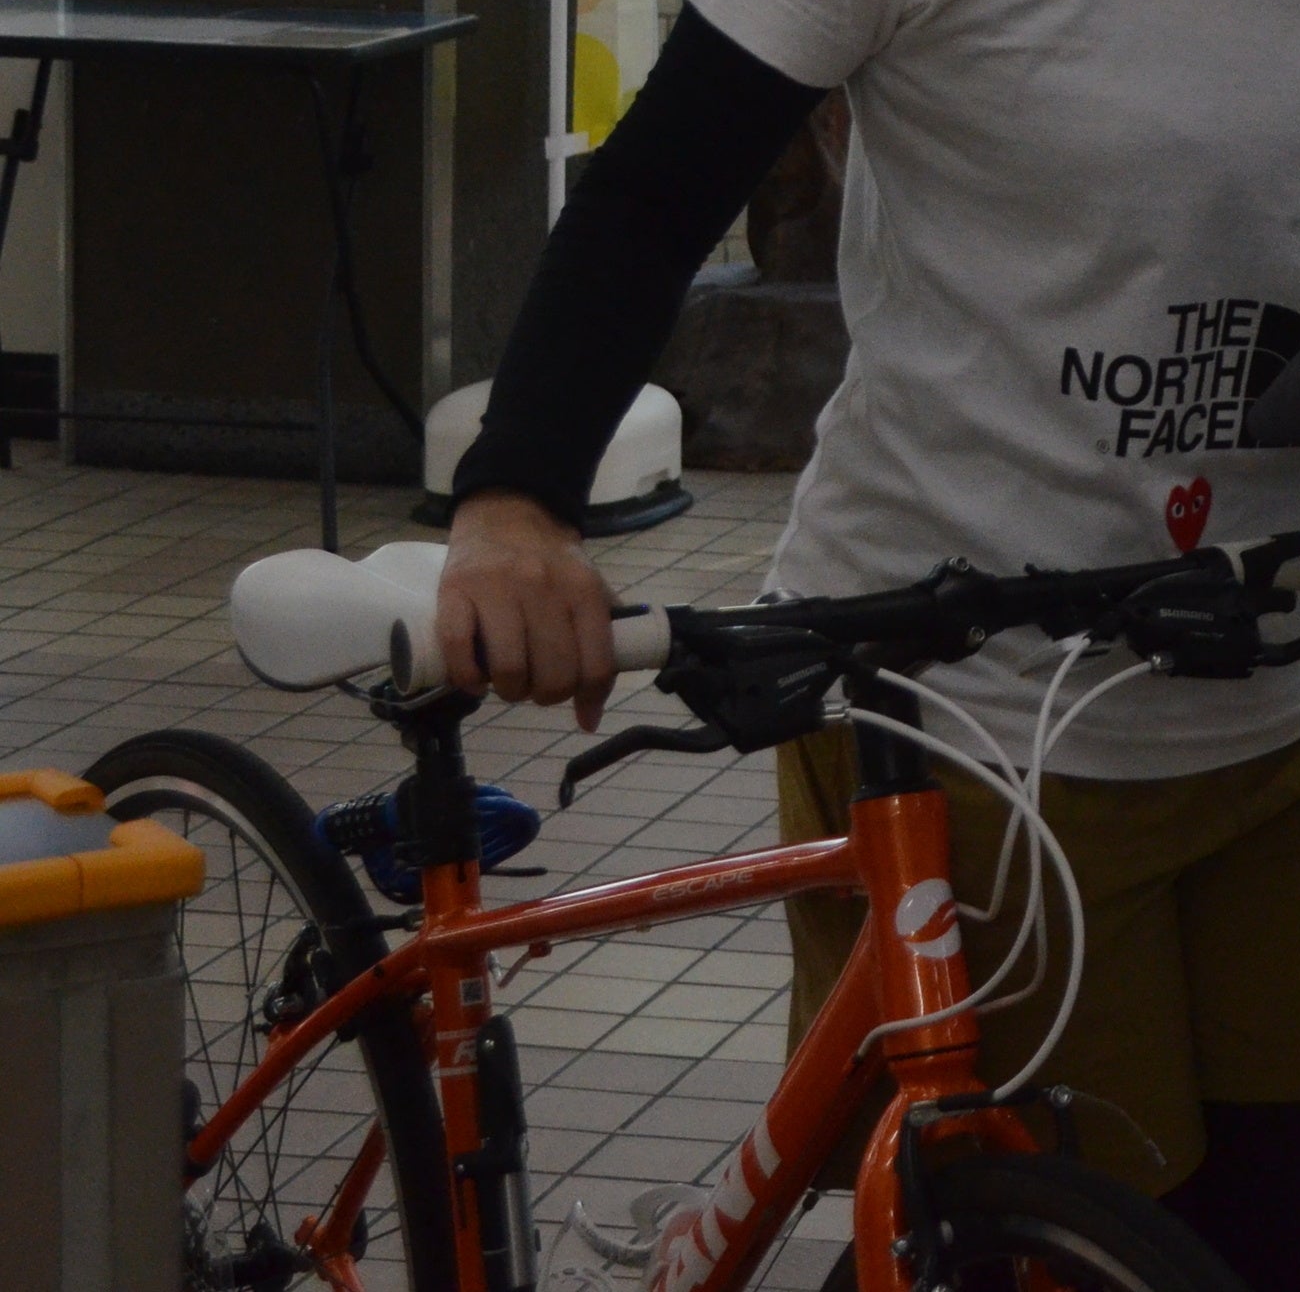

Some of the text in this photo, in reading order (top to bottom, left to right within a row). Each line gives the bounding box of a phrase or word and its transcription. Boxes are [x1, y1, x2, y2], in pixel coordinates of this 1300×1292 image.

[1167, 297, 1260, 354] THE
[1060, 346, 1248, 407] NORTH
[1115, 401, 1240, 459] FACE
[652, 869, 753, 902] ESCAPE
